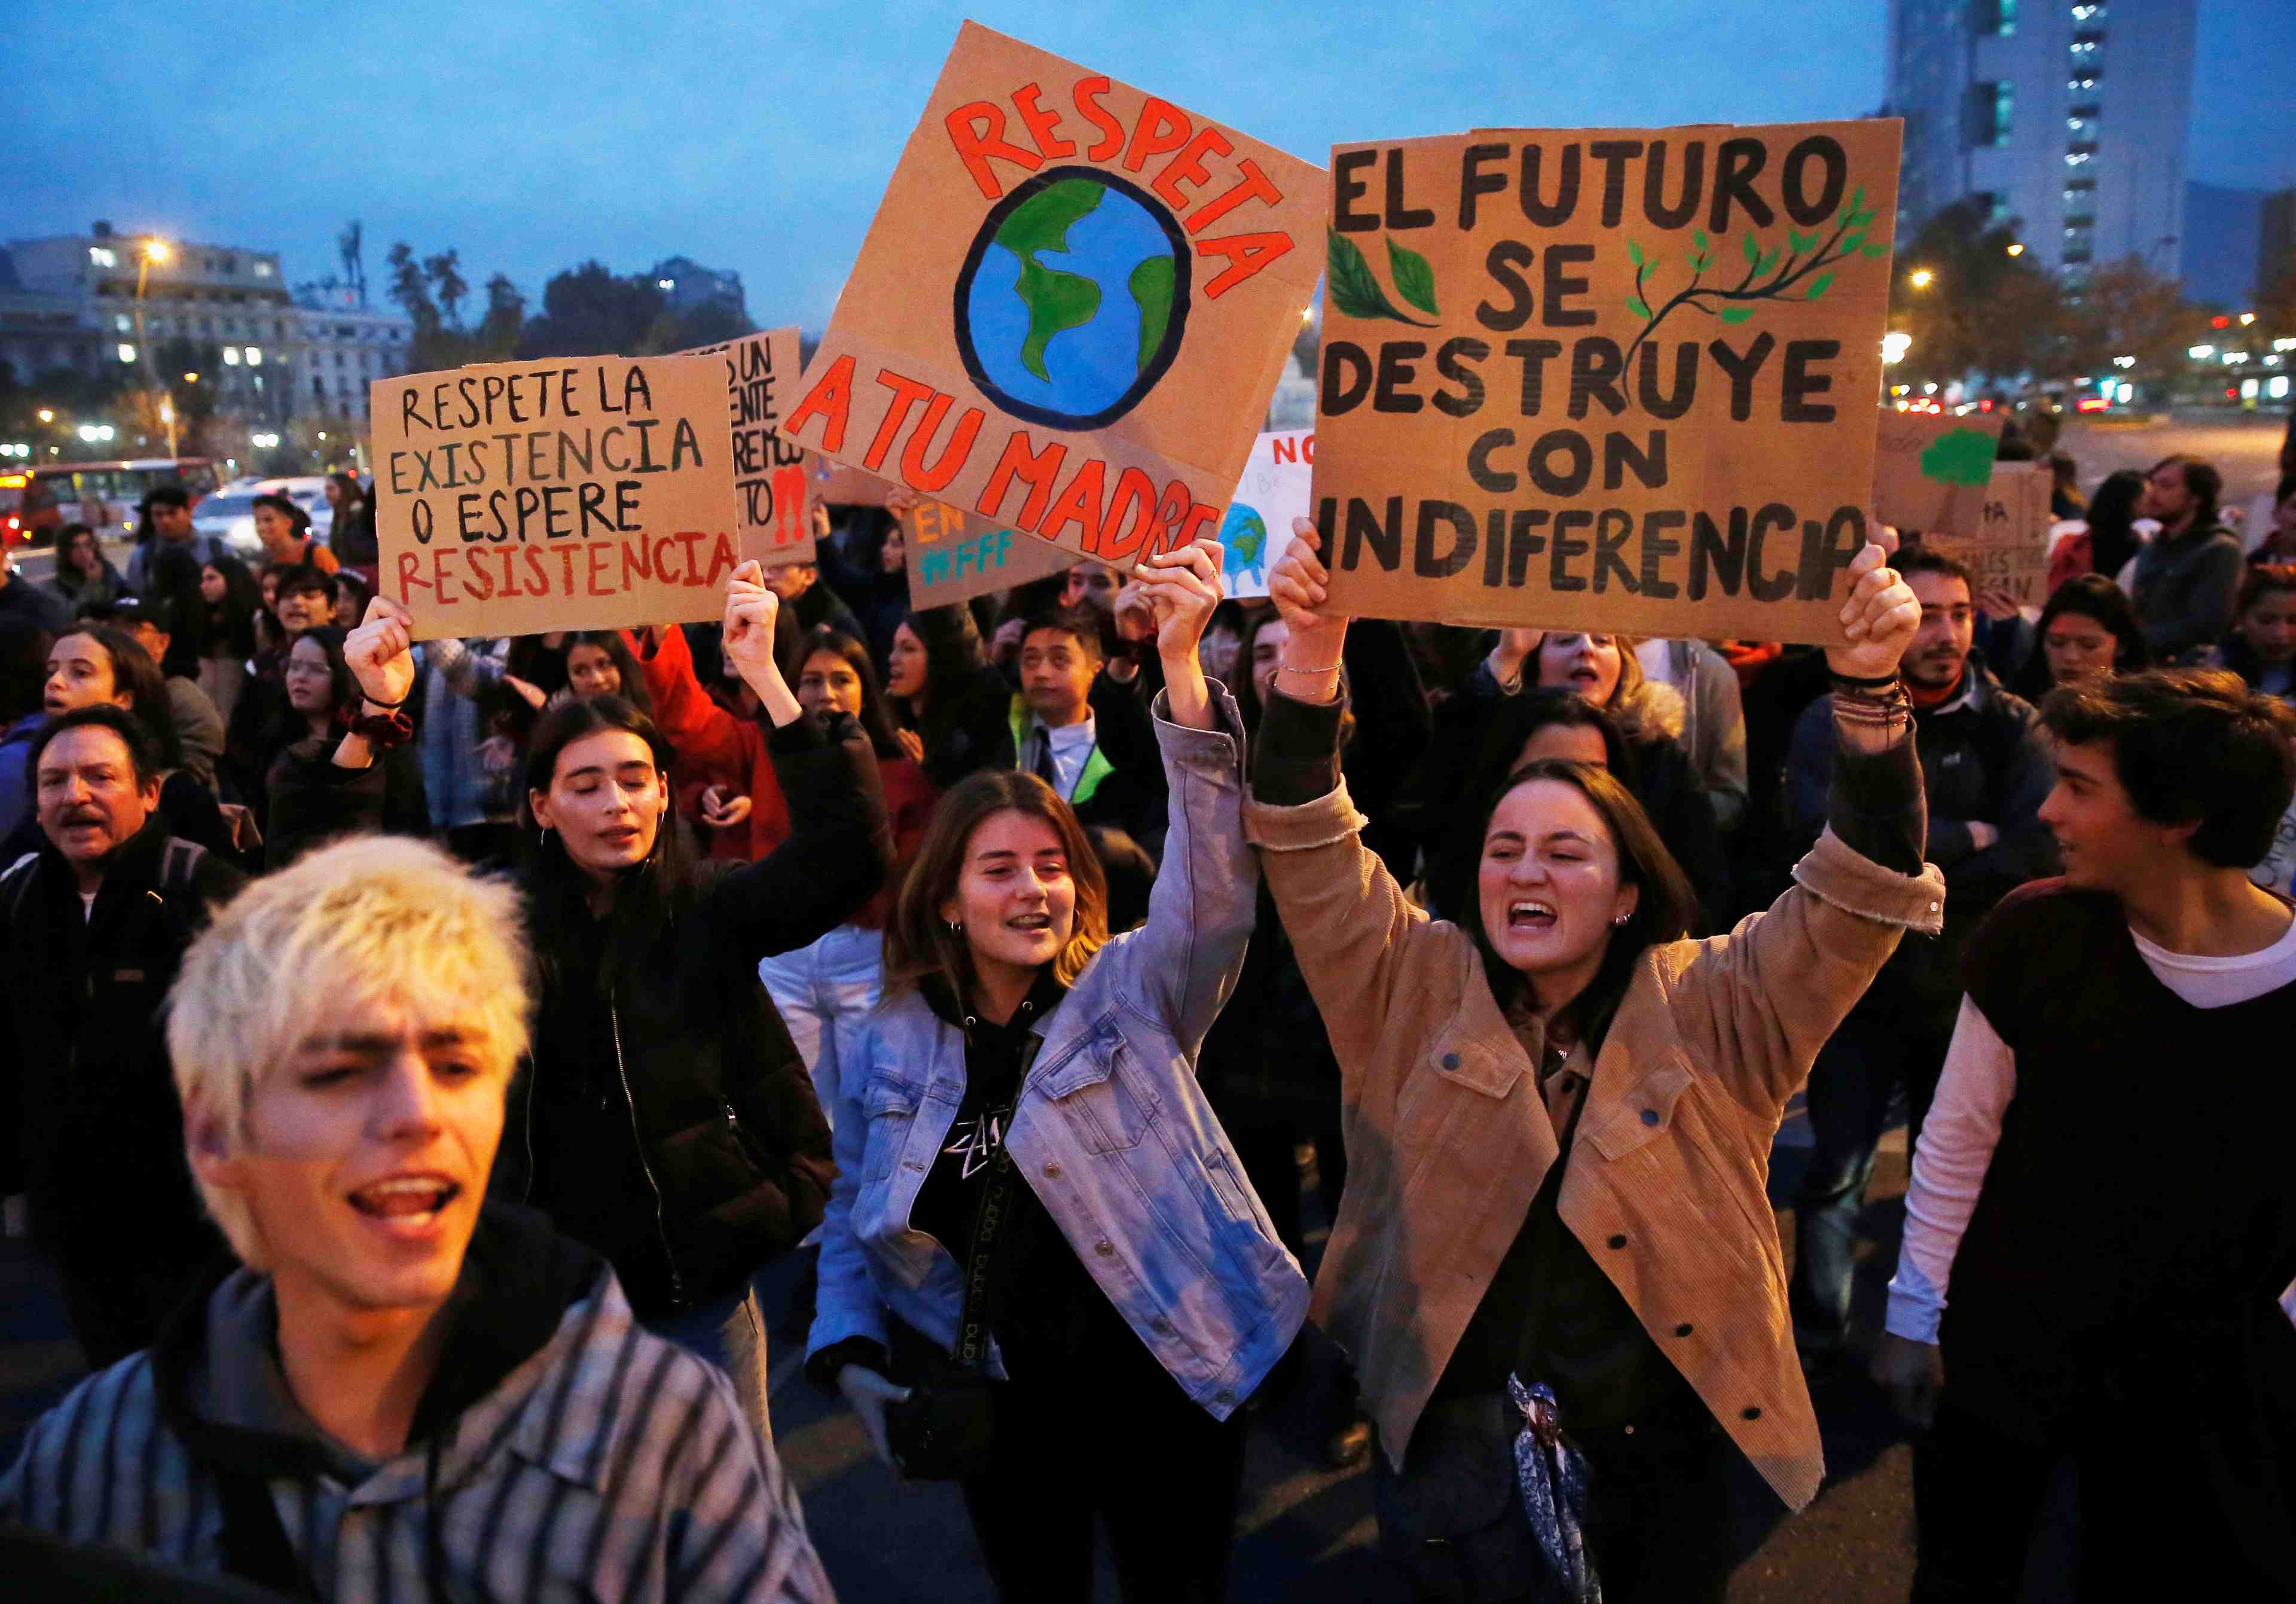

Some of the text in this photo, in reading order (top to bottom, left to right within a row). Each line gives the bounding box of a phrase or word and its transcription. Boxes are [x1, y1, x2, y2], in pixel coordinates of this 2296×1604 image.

[945, 76, 1295, 300] RESPETA
[1335, 135, 1848, 234] EL FUTURO
[1475, 240, 1596, 331] SE
[740, 337, 771, 382] UN
[1319, 331, 1840, 423] DESTRUYE
[403, 365, 651, 437] RESPETE LA
[784, 354, 856, 453] A
[863, 369, 985, 493] TU
[391, 417, 703, 495] EXISTENCIA
[1467, 427, 1668, 497] CON
[412, 481, 643, 544] O ESPERE
[915, 501, 966, 543] EN
[1315, 496, 1866, 602] INDIFERENCIA
[398, 532, 740, 605] RESISTENCIA
[918, 530, 1012, 586] #FFF
